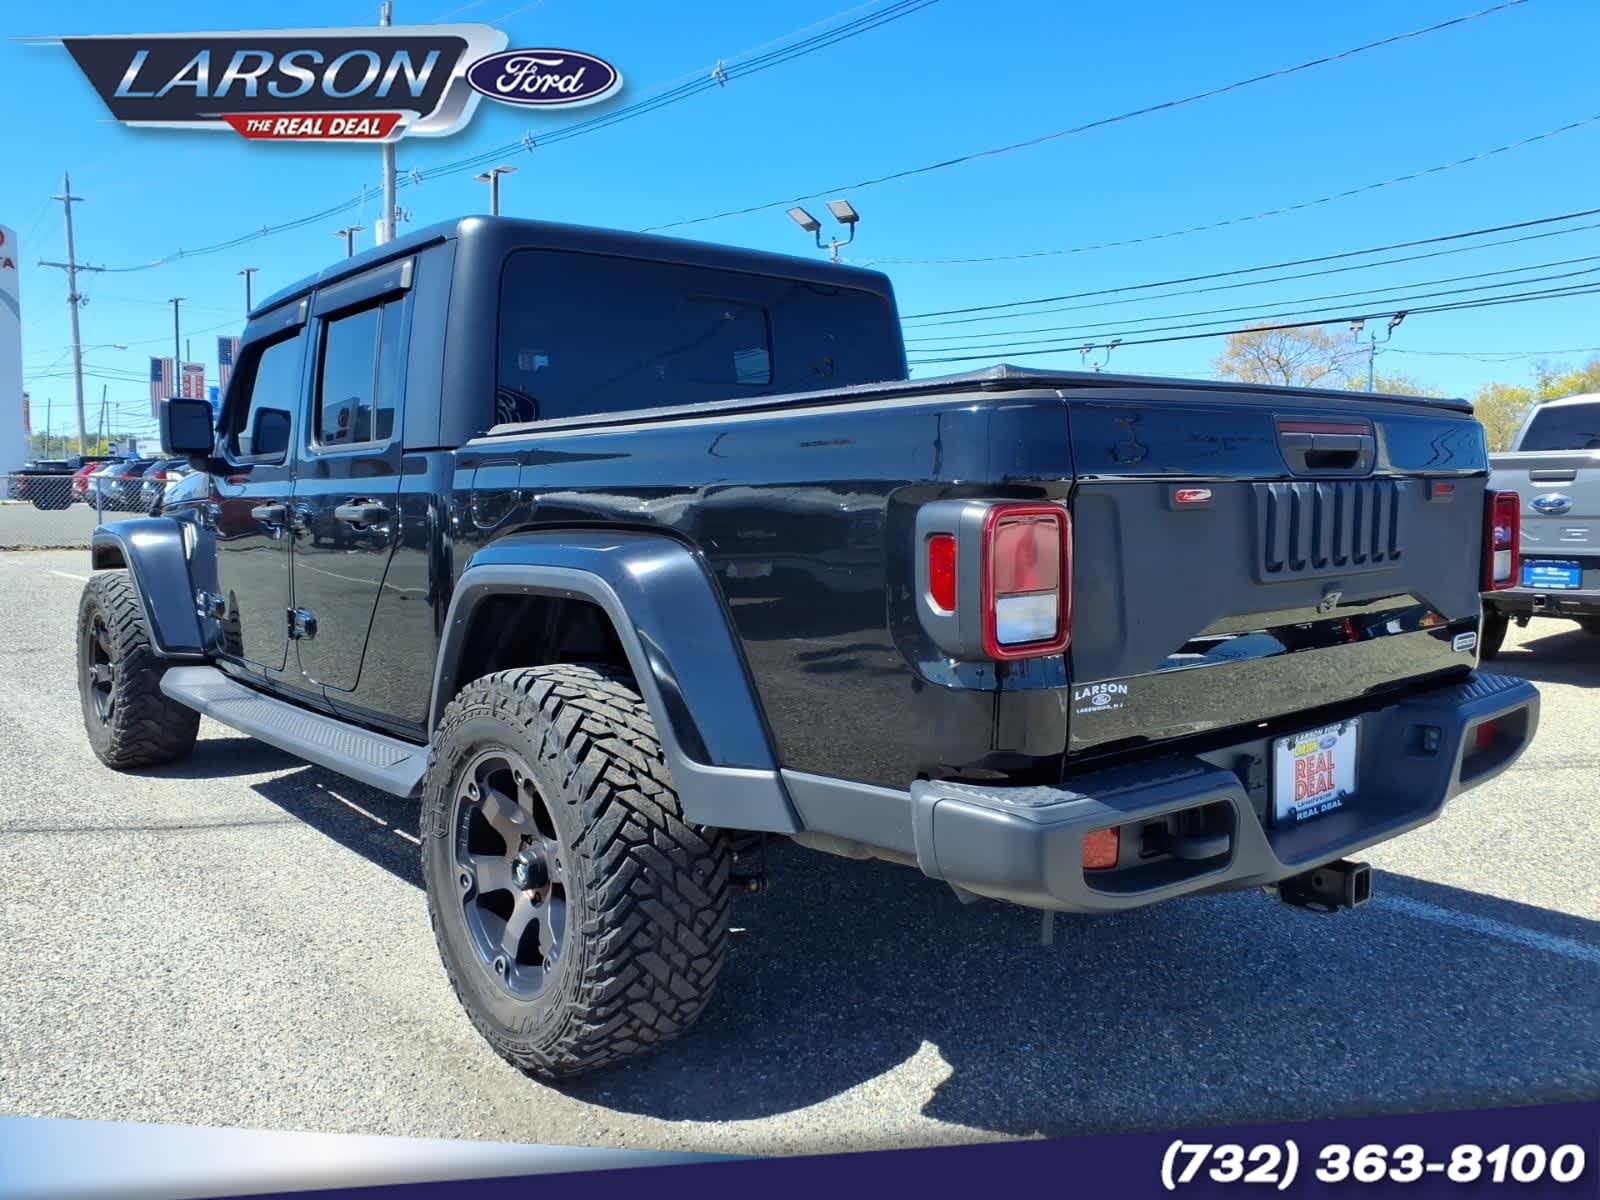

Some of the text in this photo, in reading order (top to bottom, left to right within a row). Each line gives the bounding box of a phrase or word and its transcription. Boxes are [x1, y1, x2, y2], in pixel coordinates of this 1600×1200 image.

[1074, 683, 1128, 701] LARSON
[1295, 750, 1335, 780] REAL
[1294, 771, 1335, 802] DEAL
[1296, 806, 1320, 820] REAL
[1321, 799, 1342, 812] DEAL
